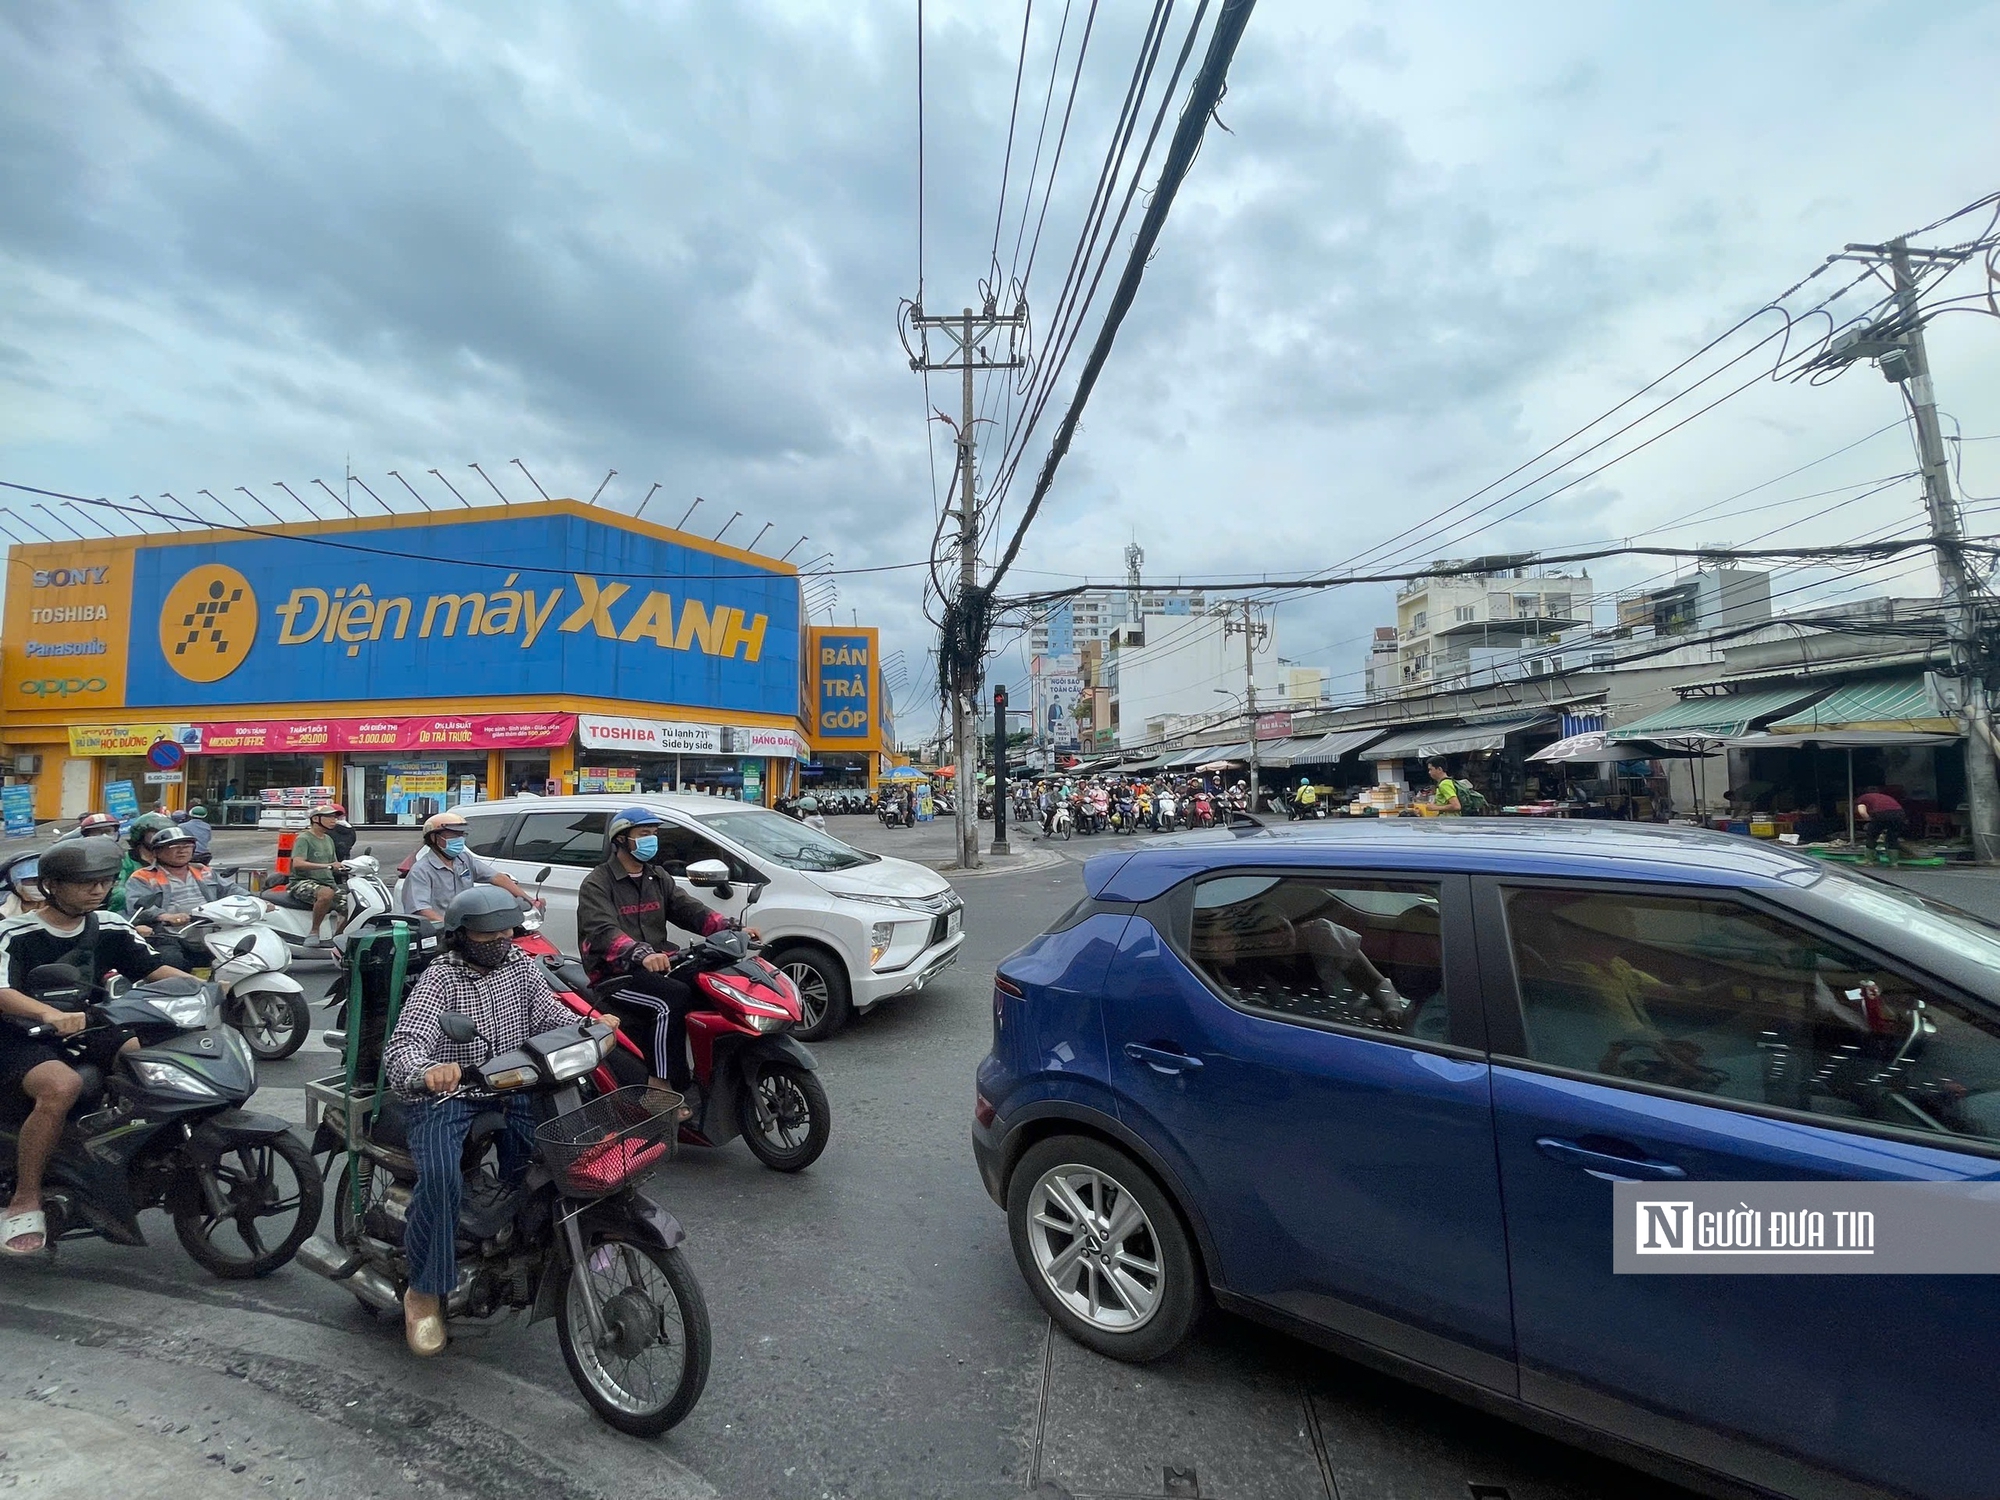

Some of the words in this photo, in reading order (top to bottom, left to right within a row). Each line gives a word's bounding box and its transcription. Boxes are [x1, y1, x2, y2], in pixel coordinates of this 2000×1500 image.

[31, 604, 108, 624] TOSHIBA
[275, 581, 413, 657] Điện
[419, 572, 564, 649] máy
[557, 572, 768, 662] XANH
[26, 637, 107, 658] Panasonic
[821, 644, 867, 665] BÁN
[822, 673, 866, 697] TRẢ
[1051, 677, 1066, 685] NGÔI
[1050, 685, 1068, 693] TOÀN
[821, 706, 867, 729] GÓP
[455, 720, 472, 729] SUẤT
[243, 736, 266, 746] OFFICE
[358, 733, 396, 744] 3.000.000
[432, 729, 446, 742] TRẢ
[448, 729, 472, 742] TRƯỚC
[589, 725, 656, 741] TOSHIBA
[661, 727, 673, 737] Tủ
[674, 728, 694, 739] lạnh
[752, 733, 776, 745] HÀNG
[100, 738, 118, 750] HỌC
[662, 739, 682, 748] Side
[683, 740, 694, 750] by
[695, 741, 713, 750] side
